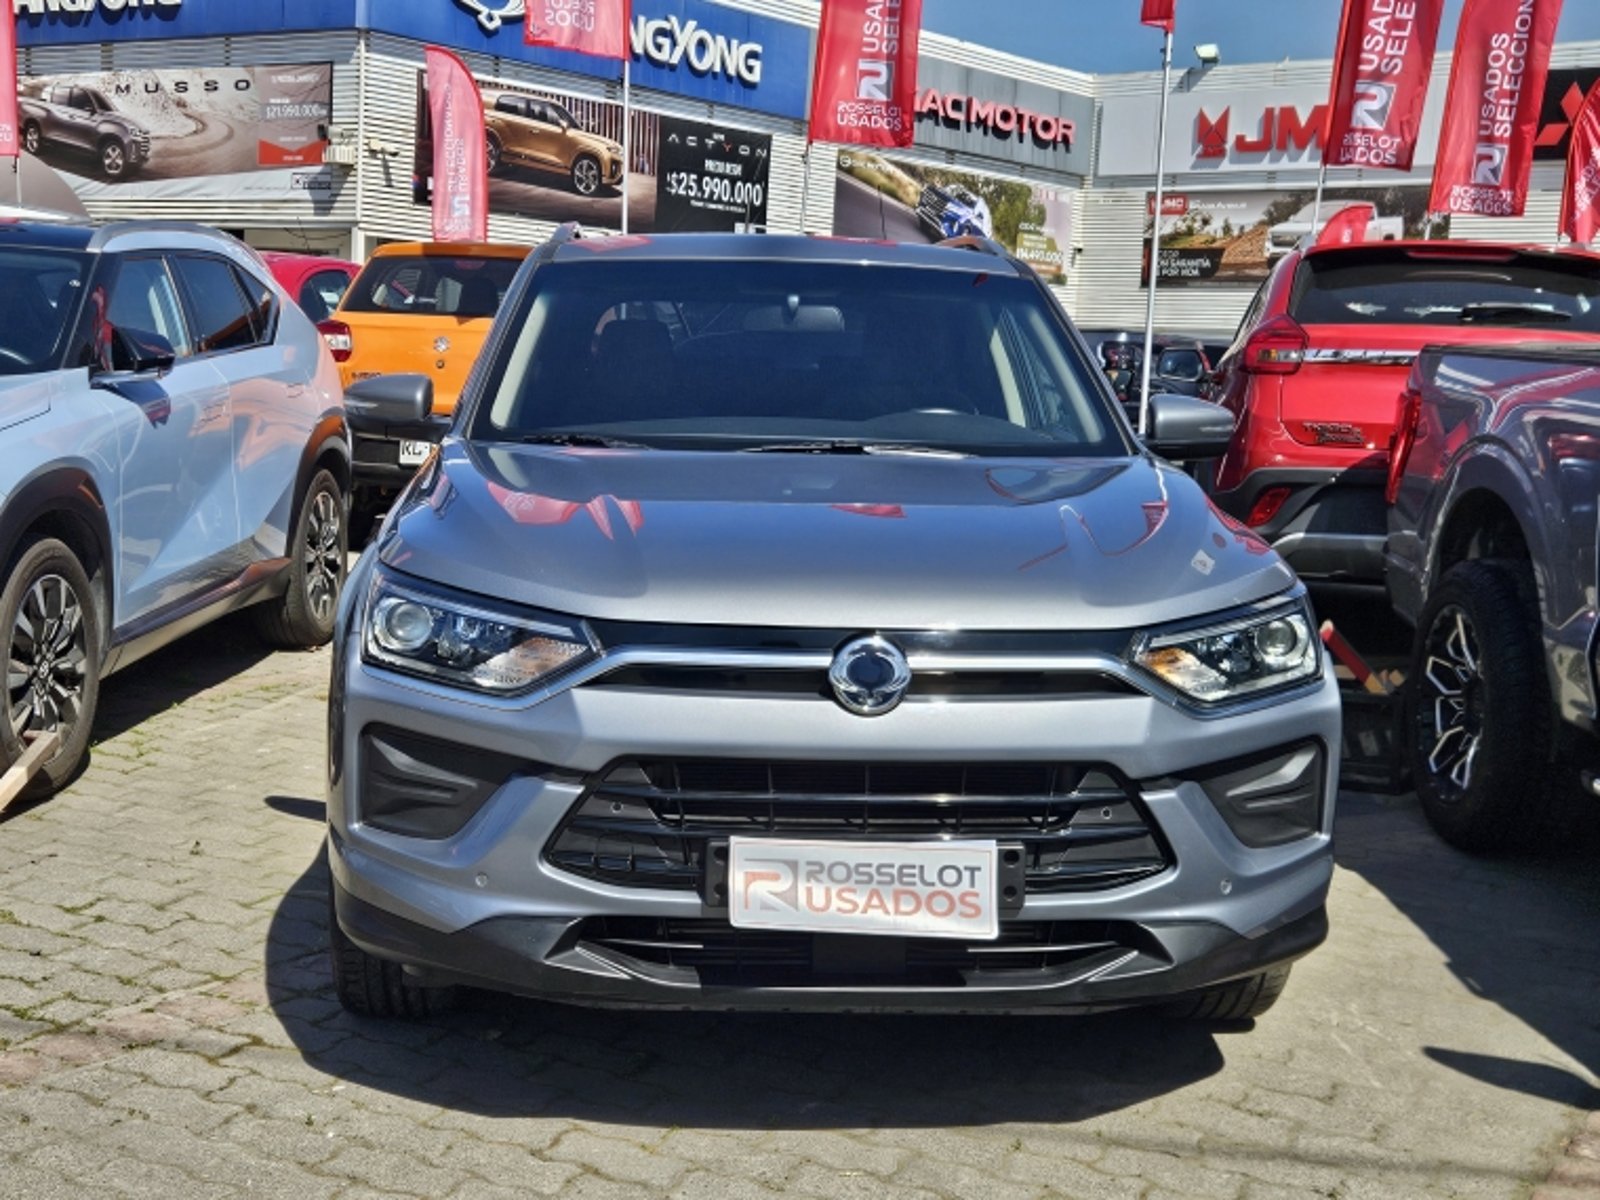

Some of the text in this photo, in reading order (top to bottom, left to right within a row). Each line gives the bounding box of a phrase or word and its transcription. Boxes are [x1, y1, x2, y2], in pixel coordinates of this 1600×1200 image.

[862, 0, 884, 52] USA
[115, 79, 252, 94] MUSSO
[1479, 32, 1511, 136] USADOS
[837, 113, 902, 131] USADOS
[914, 88, 1076, 145] AC MOTOR
[1340, 146, 1397, 164] UADOS
[1450, 196, 1513, 215] USADOS
[805, 860, 982, 889] ROSSELOT
[805, 886, 982, 919] USADOS
